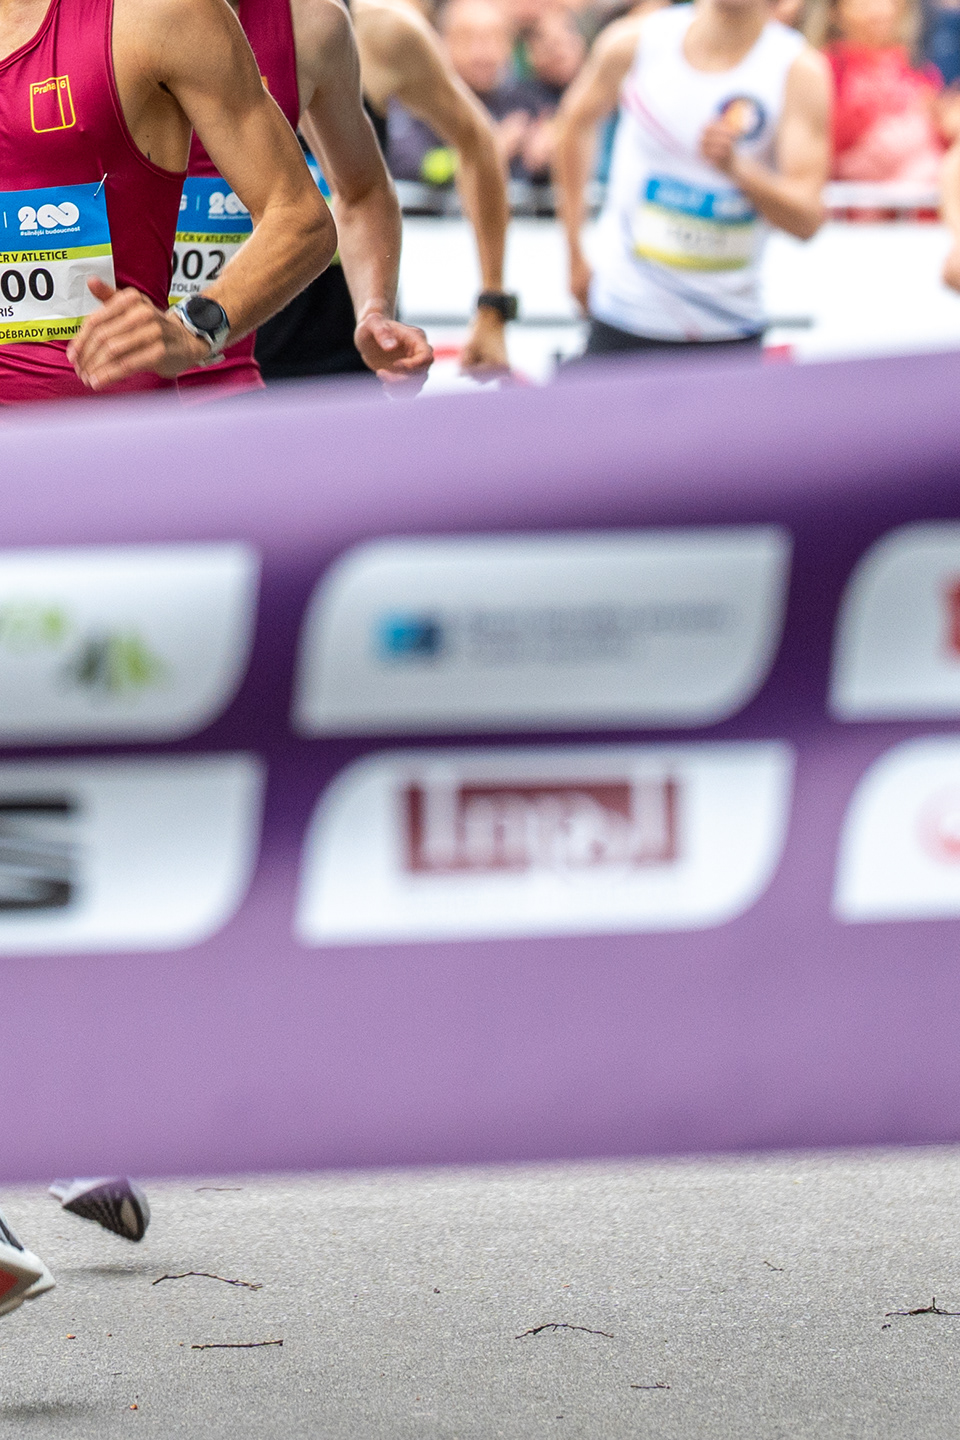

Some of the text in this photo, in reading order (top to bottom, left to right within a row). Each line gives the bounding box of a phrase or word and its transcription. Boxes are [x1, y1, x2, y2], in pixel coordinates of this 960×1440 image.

[34, 80, 66, 95] Praha 6
[17, 201, 80, 231] 200
[11, 253, 19, 262] V
[21, 250, 68, 262] ATLETICE
[172, 249, 226, 280] 02
